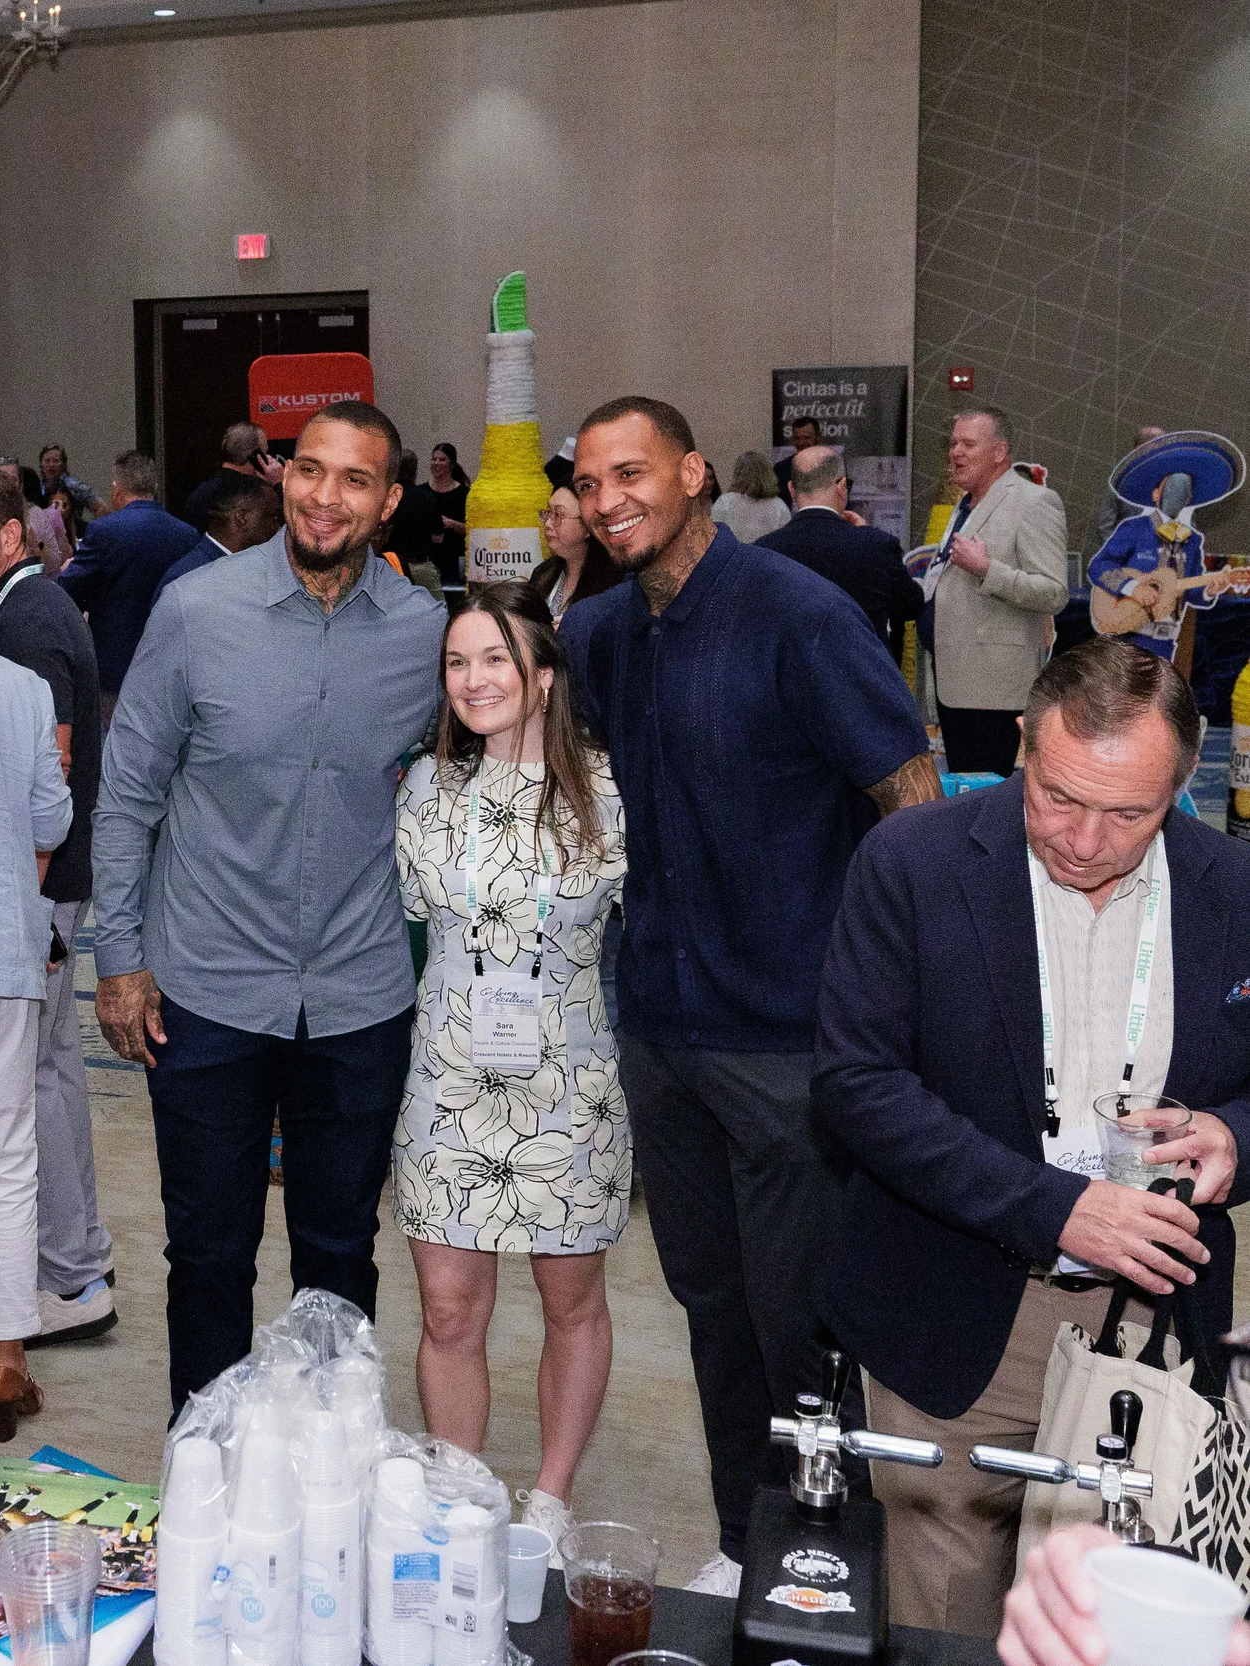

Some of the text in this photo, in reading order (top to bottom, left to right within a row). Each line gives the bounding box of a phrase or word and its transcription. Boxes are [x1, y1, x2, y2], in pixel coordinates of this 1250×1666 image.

[238, 234, 267, 259] EXIT
[278, 392, 361, 406] KUSTOM
[783, 381, 868, 397] Cintas is a
[782, 400, 865, 420] perfect fit
[475, 547, 532, 569] Corona
[486, 565, 516, 577] Extra
[469, 792, 479, 820] Littler
[466, 835, 477, 864] Littler
[467, 880, 478, 908] Littler
[1145, 878, 1161, 921] Littler
[538, 894, 549, 920] Littler
[1136, 940, 1155, 985] Littler
[496, 1022, 514, 1030] Sara
[1127, 1003, 1147, 1047] Littler
[243, 1600, 263, 1613] 100
[314, 1597, 334, 1609] 100
